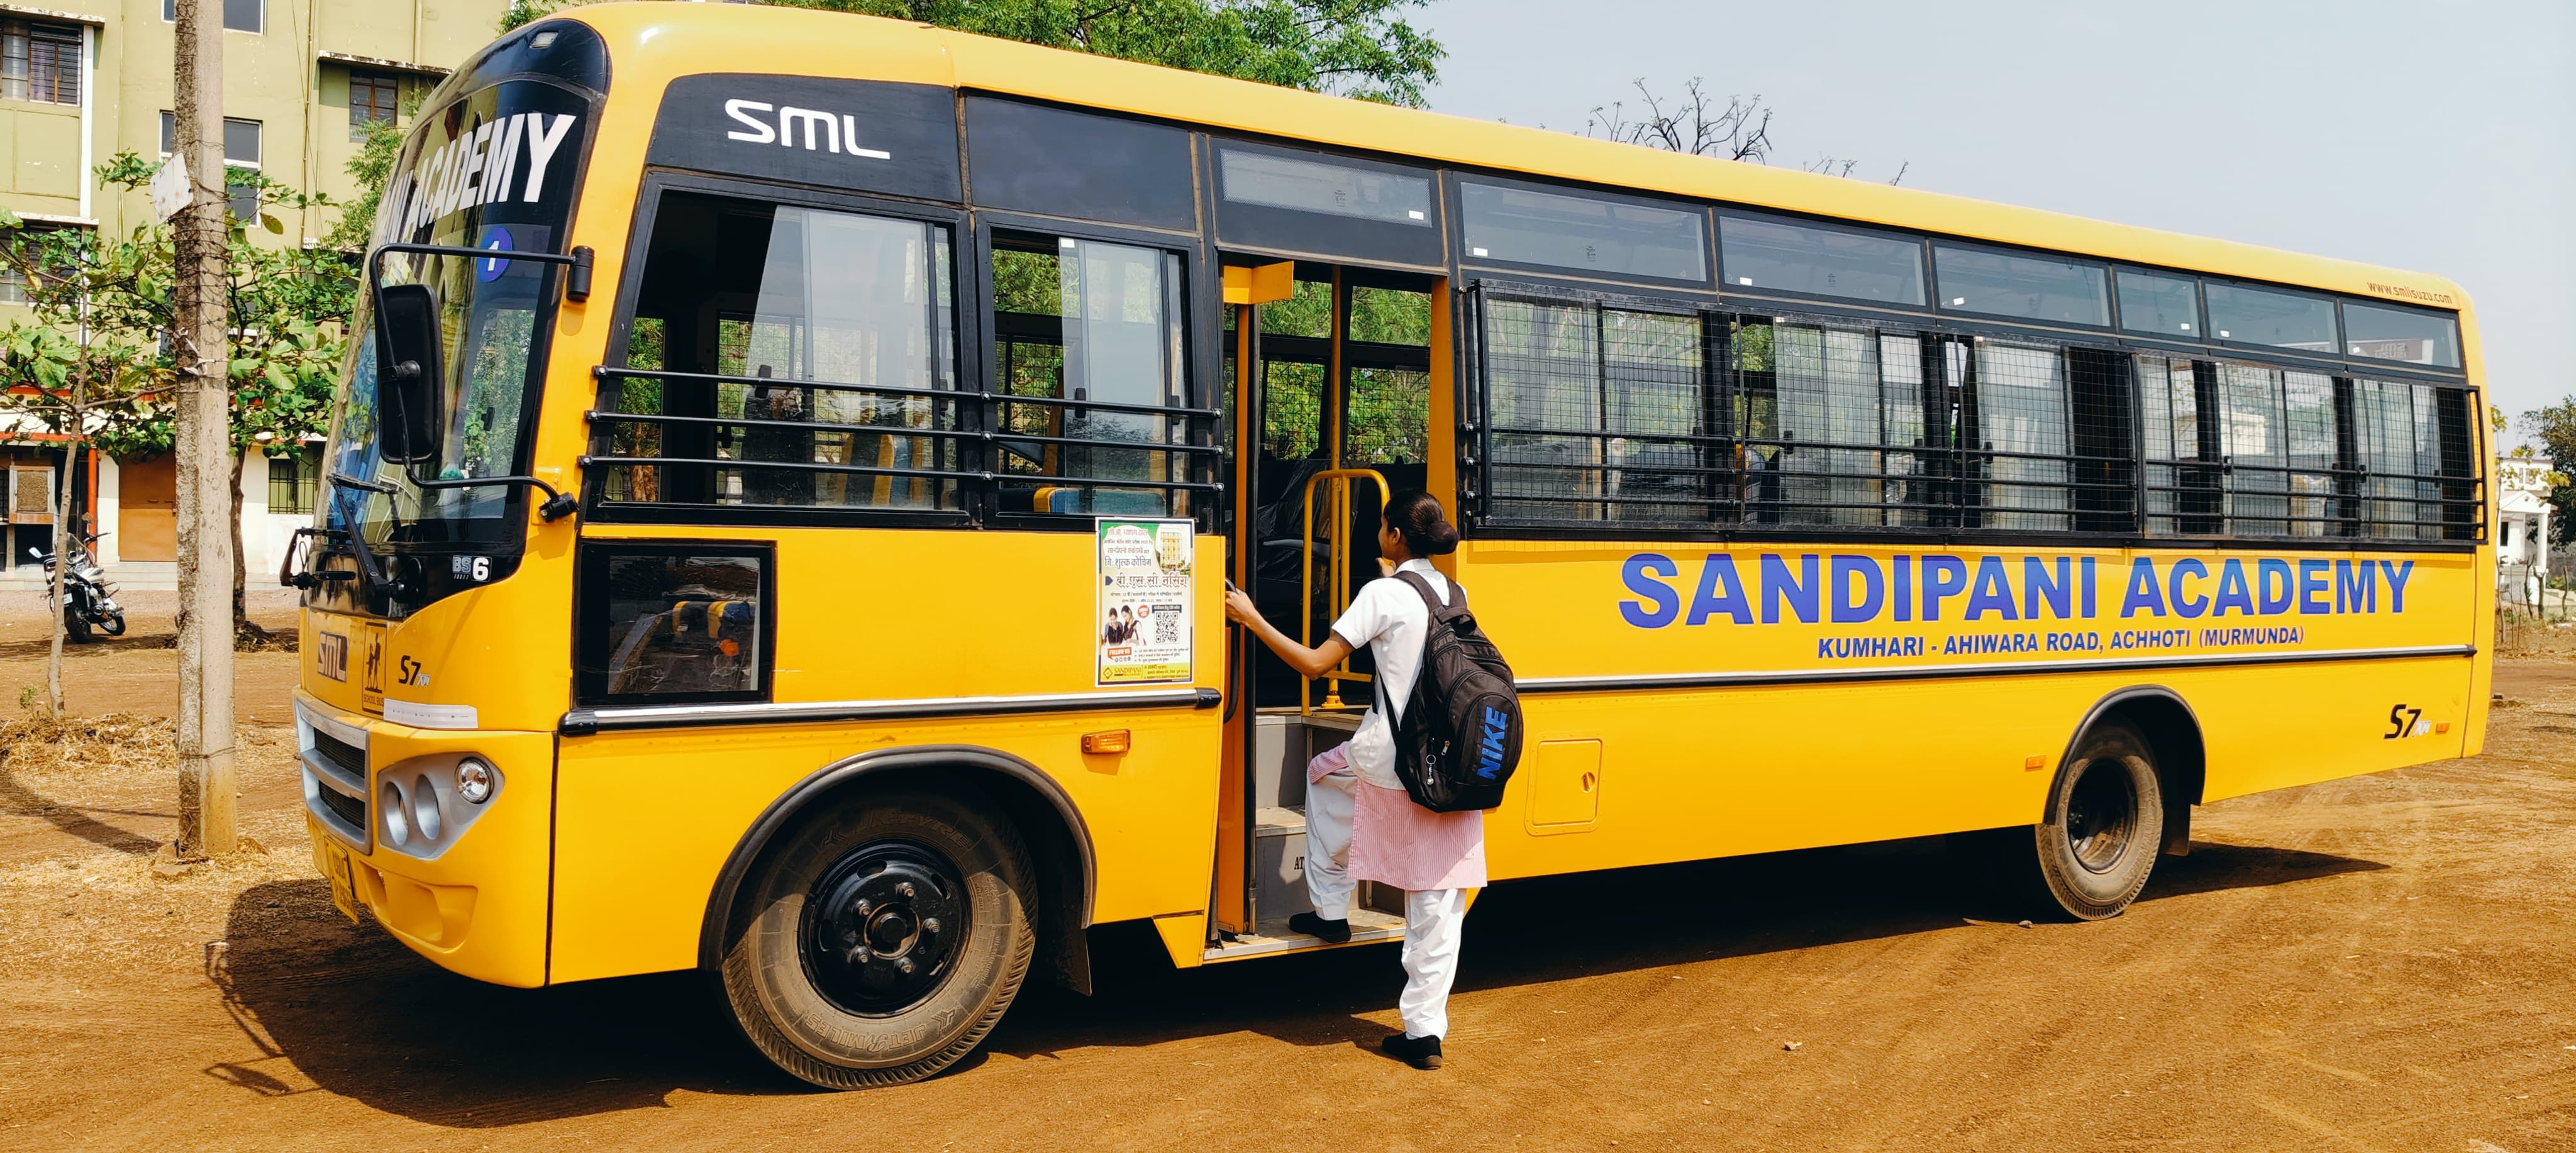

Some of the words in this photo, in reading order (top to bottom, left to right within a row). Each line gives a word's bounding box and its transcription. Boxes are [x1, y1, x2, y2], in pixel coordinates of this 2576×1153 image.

[724, 99, 891, 160] SML
[401, 112, 577, 244] ACADEMY
[487, 240, 500, 272] 1
[2367, 282, 2453, 305] www.smlisuzu.com
[1619, 553, 2096, 629] SANDIPANI
[2119, 557, 2415, 618] ACADEMY
[317, 631, 347, 682] SML
[1818, 636, 1924, 659] KUMHARI
[1943, 632, 2038, 655] AHIWARA
[2046, 632, 2104, 654] ROAD,
[2109, 629, 2190, 649] ACHHOTI
[2199, 626, 2304, 647] (MURMUNDA)
[364, 693, 376, 705] SCHOOL
[1477, 706, 1507, 780] NIKE
